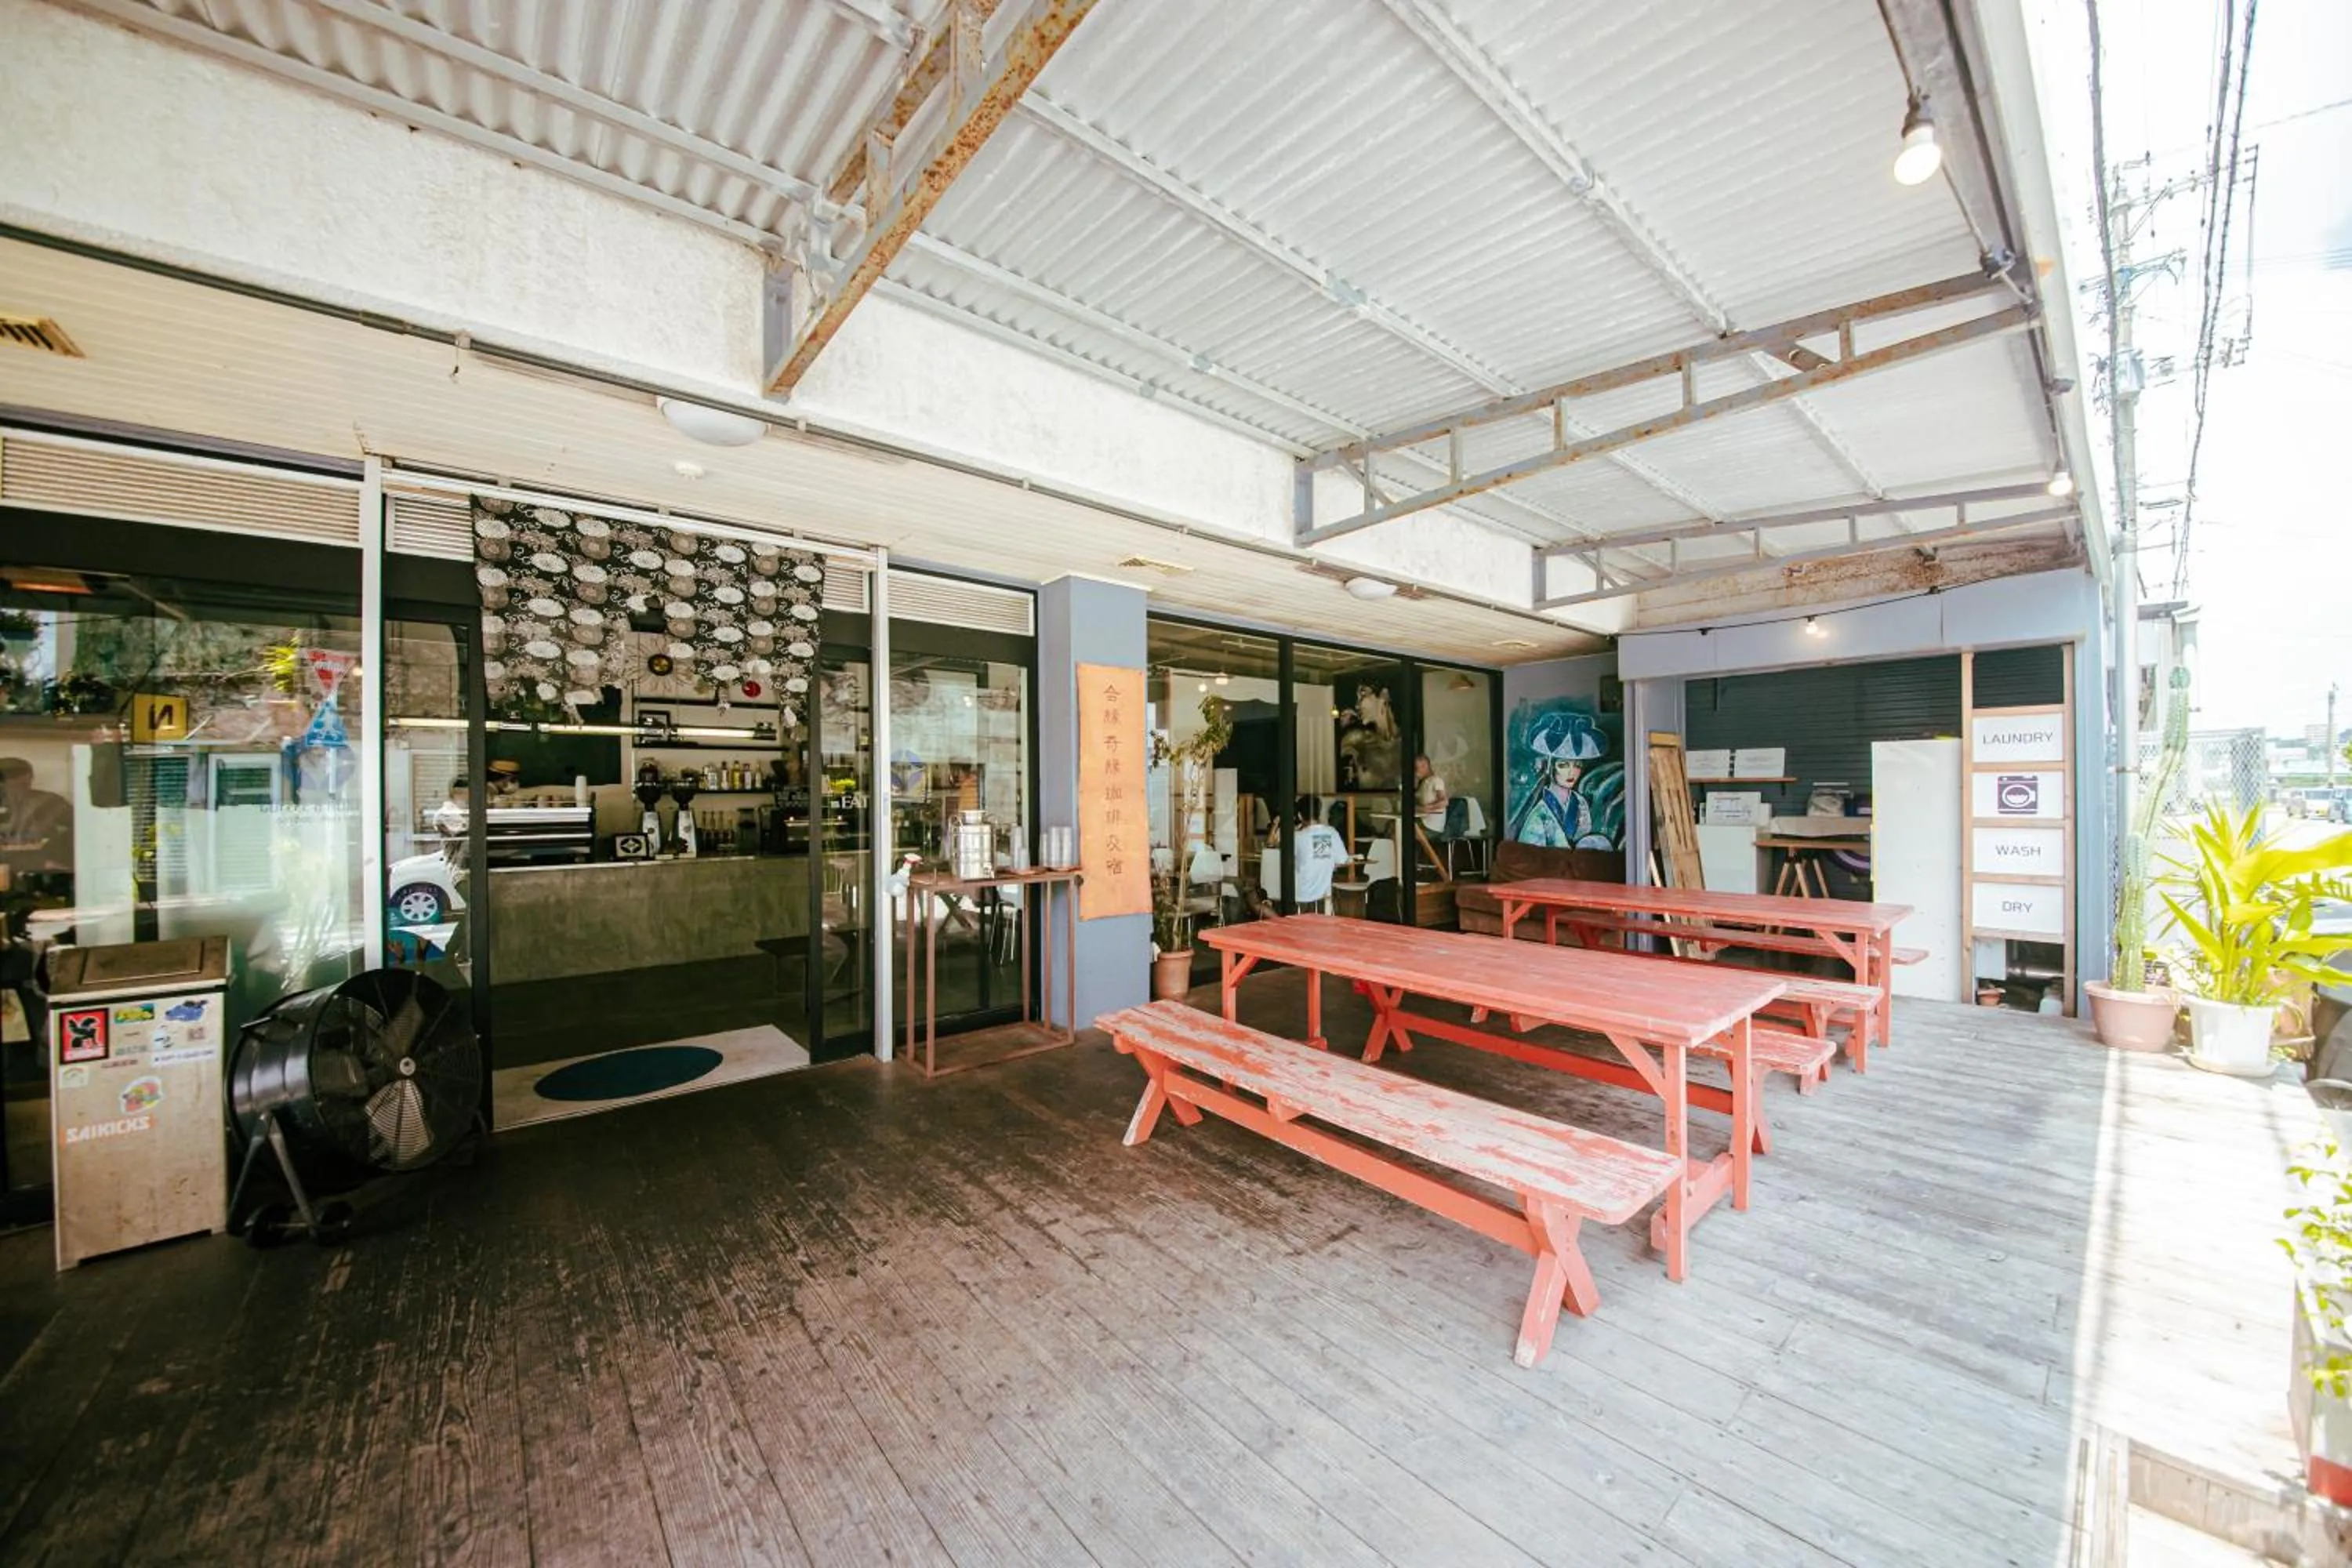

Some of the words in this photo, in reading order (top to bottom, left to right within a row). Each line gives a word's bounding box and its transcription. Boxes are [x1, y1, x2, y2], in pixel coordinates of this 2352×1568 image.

[1983, 731, 2053, 745] LAUNDRY
[1994, 845, 2041, 857] WASH
[2002, 901, 2033, 913] DRY
